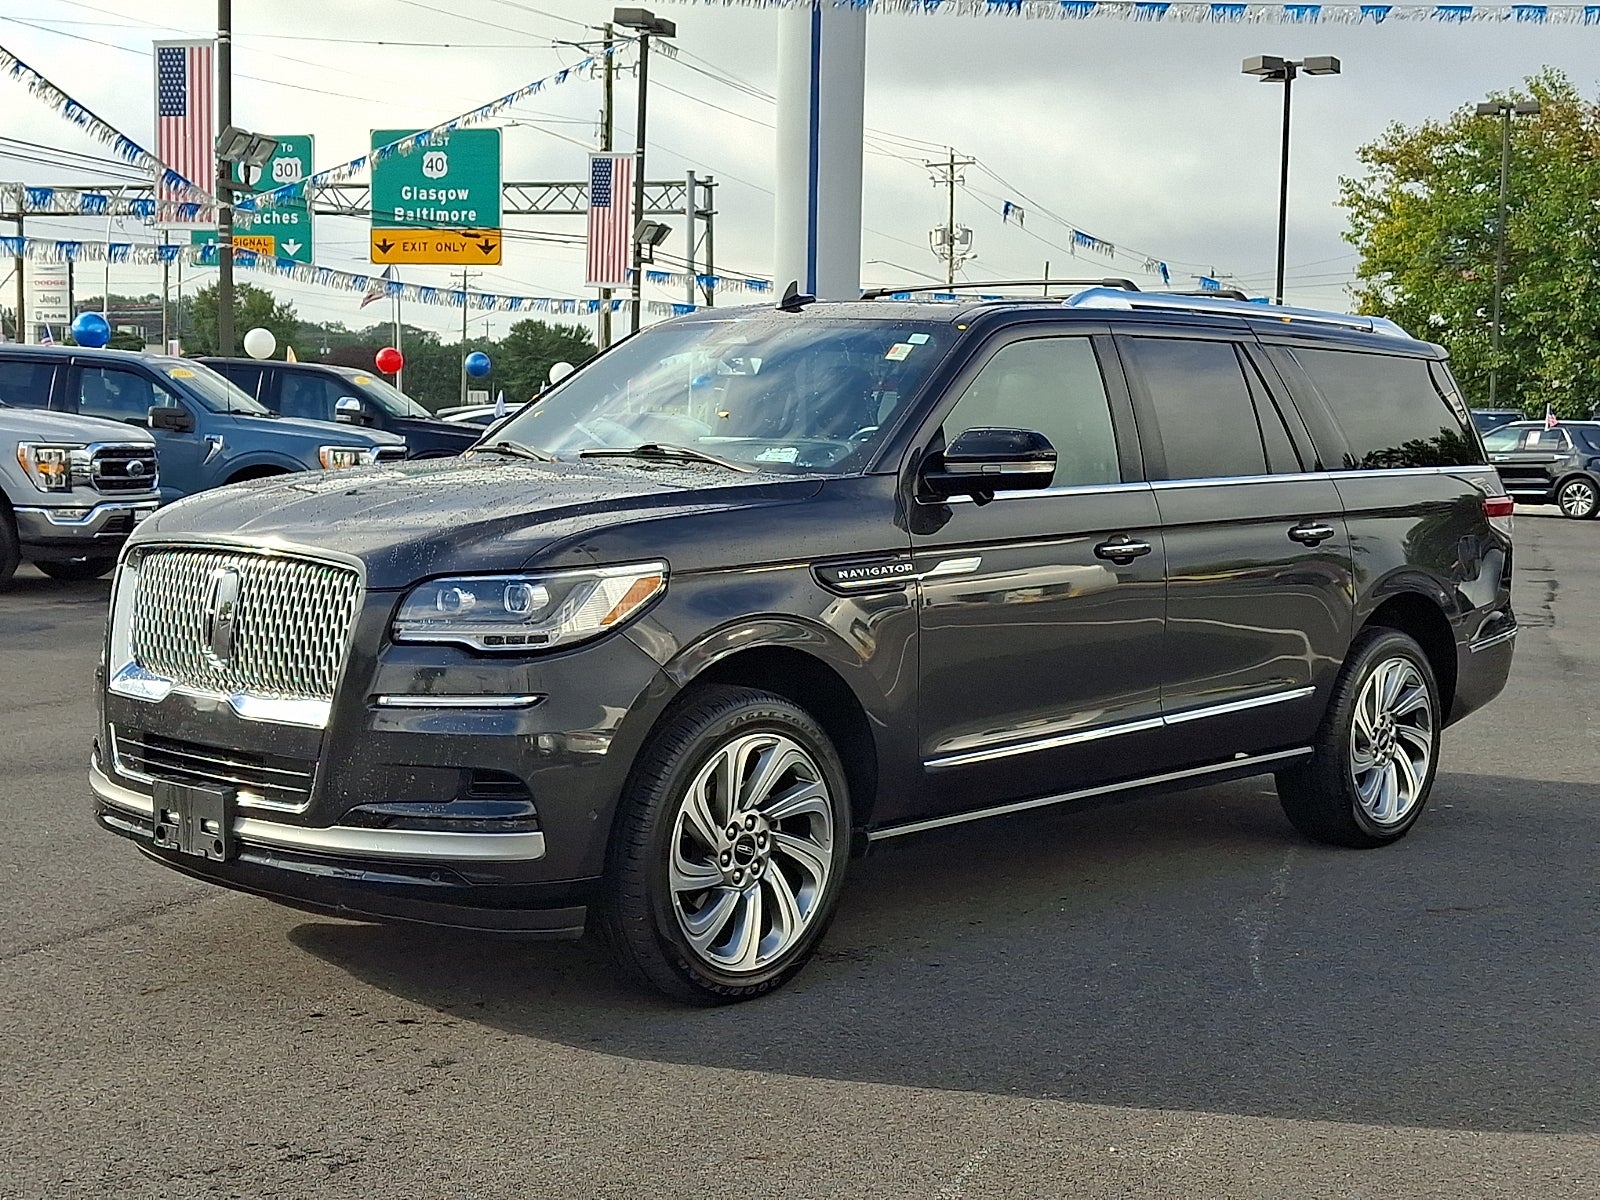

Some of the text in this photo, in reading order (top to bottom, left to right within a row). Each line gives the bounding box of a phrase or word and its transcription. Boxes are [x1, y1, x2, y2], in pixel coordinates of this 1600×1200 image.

[275, 163, 298, 178] 301
[425, 157, 444, 172] 40
[401, 186, 470, 205] Glasgow
[394, 207, 477, 222] Baltimore
[233, 238, 269, 247] SIGNAL
[402, 242, 467, 252] EXIT ONLY
[39, 293, 61, 305] Jeep
[837, 563, 913, 579] NAVIGATOR
[725, 711, 779, 730] EAGLE
